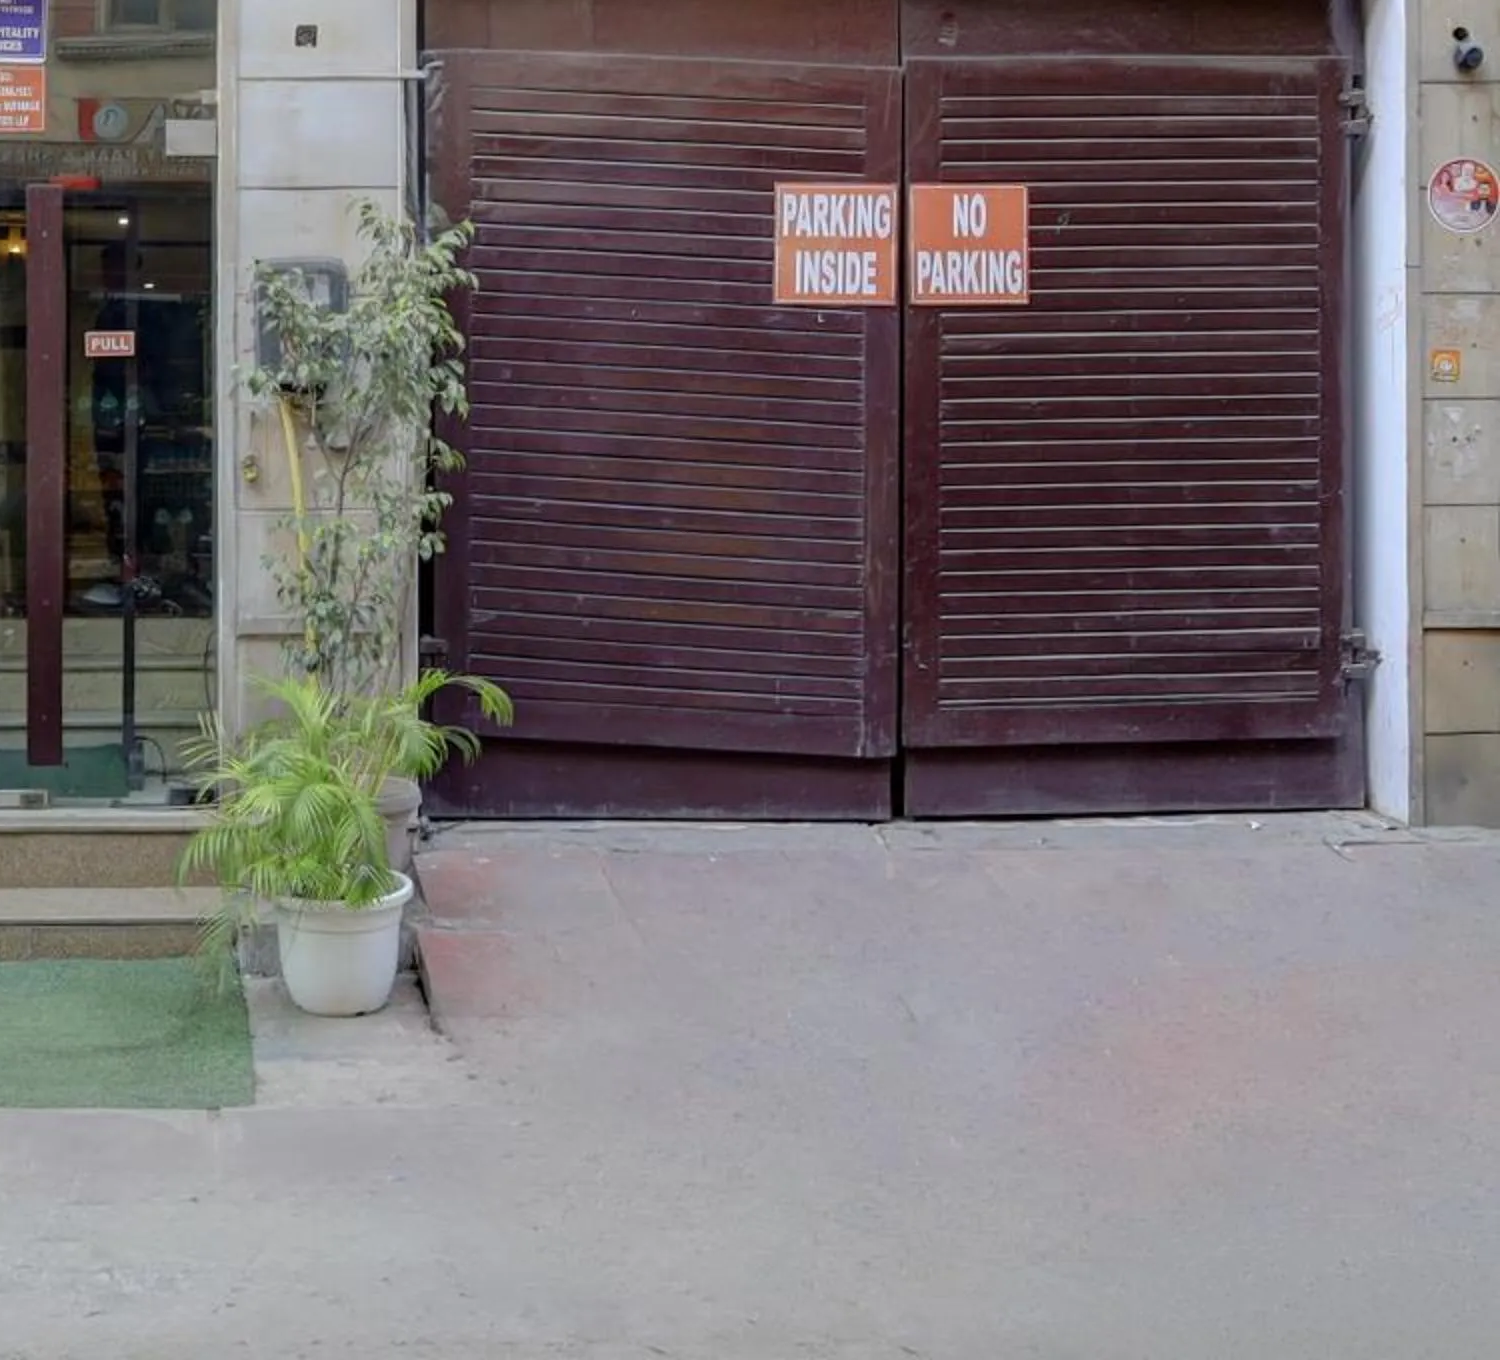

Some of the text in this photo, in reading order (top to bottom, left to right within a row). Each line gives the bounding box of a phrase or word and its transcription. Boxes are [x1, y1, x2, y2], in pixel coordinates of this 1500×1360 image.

[782, 193, 891, 238] PARKING
[953, 193, 987, 238] NO
[795, 250, 878, 295] INSIDE
[916, 250, 1022, 295] PARKING
[90, 336, 130, 351] PULL
